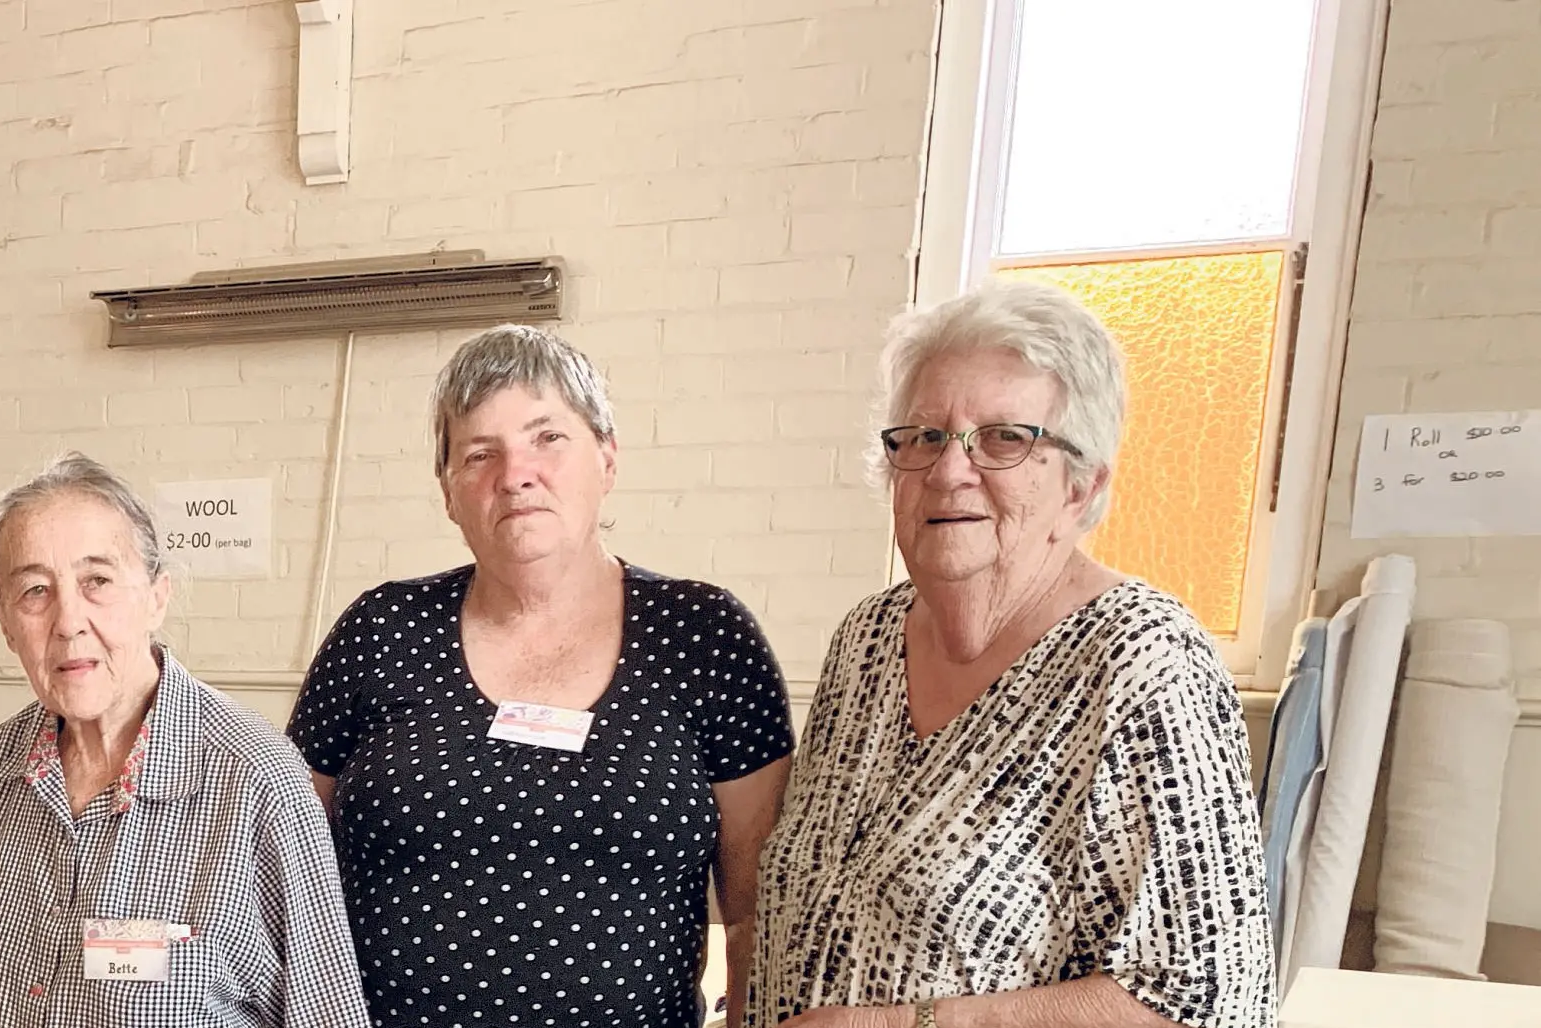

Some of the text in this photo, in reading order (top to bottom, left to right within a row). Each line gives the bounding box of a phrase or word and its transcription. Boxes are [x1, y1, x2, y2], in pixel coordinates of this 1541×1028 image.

[1410, 426, 1441, 448] Roll
[1373, 477, 1385, 492] 3
[186, 499, 238, 517] WOOL
[166, 529, 252, 551] $2-00 (per bag)
[108, 962, 138, 975] Bette
